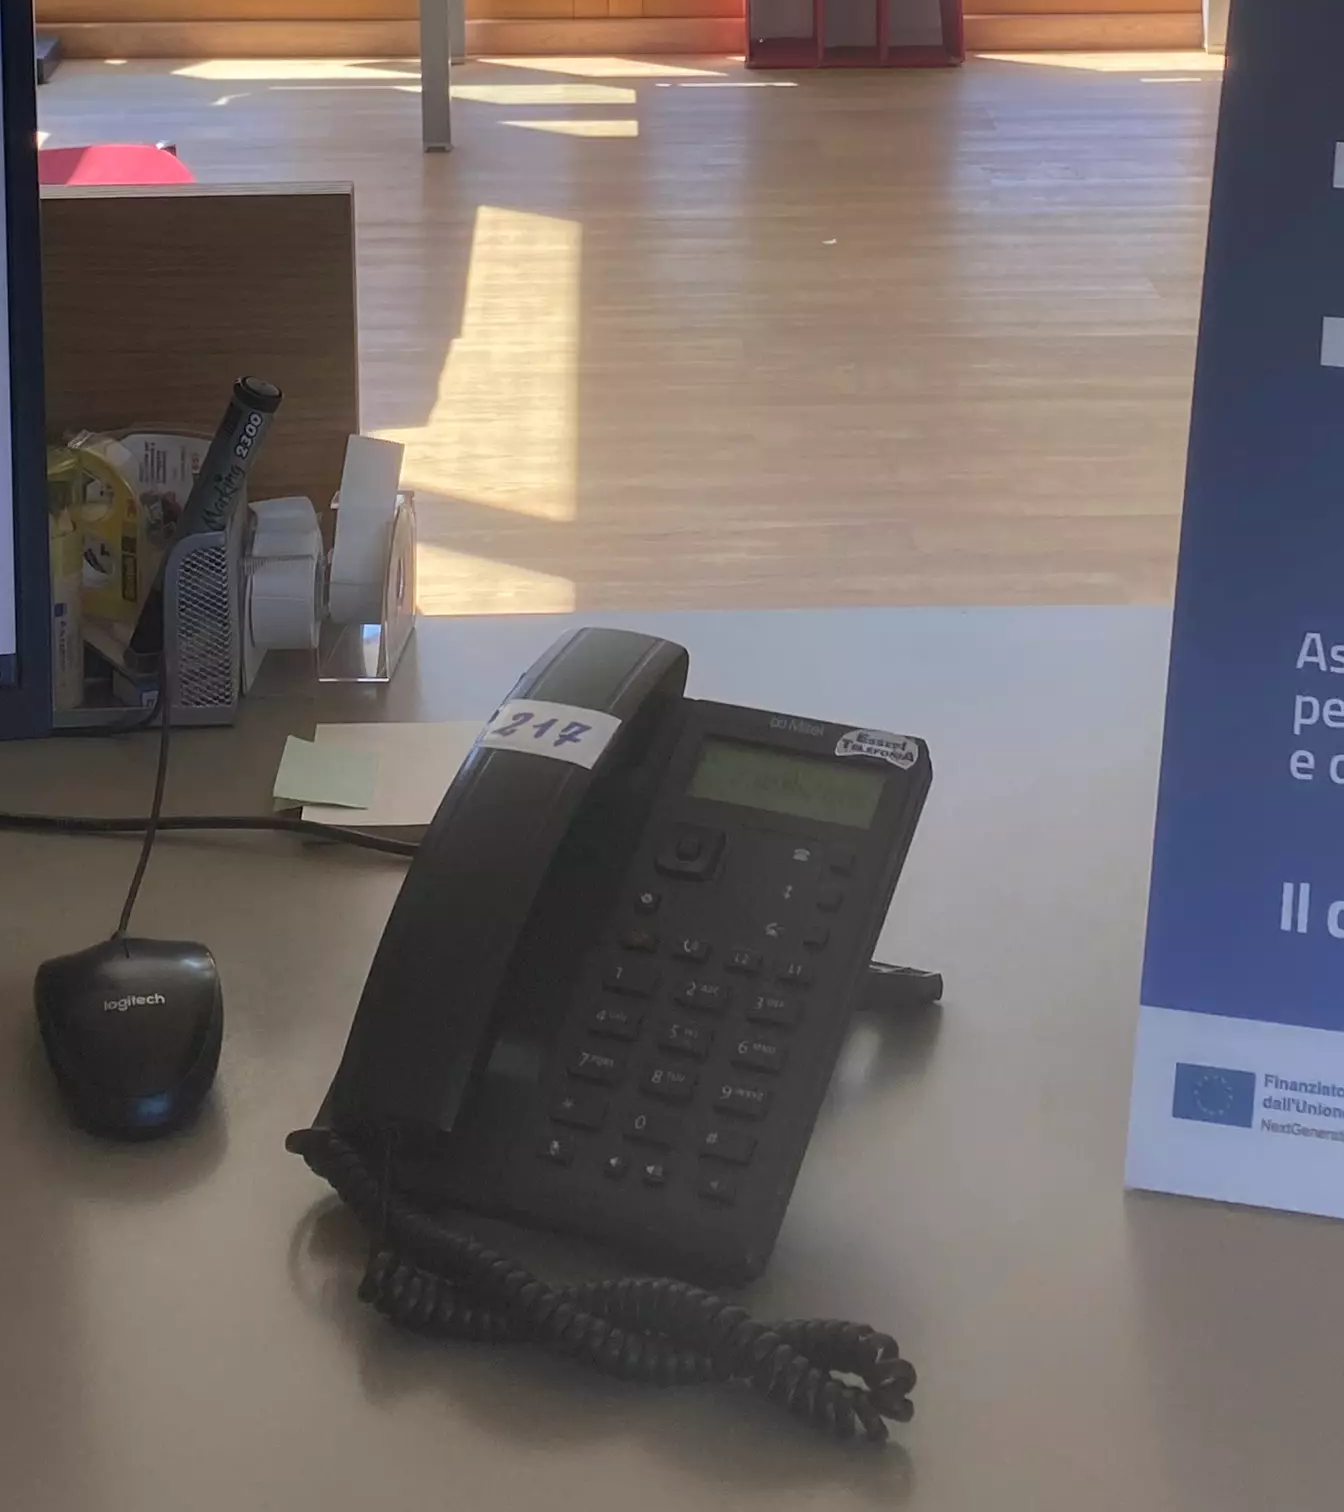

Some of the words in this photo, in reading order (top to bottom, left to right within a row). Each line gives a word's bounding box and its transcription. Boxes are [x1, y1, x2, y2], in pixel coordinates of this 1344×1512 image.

[235, 412, 263, 459] 2300
[492, 711, 593, 747] 217
[788, 719, 825, 737] Mitel
[1289, 749, 1315, 782] e
[1280, 881, 1309, 933] Il
[101, 991, 167, 1013] logitech
